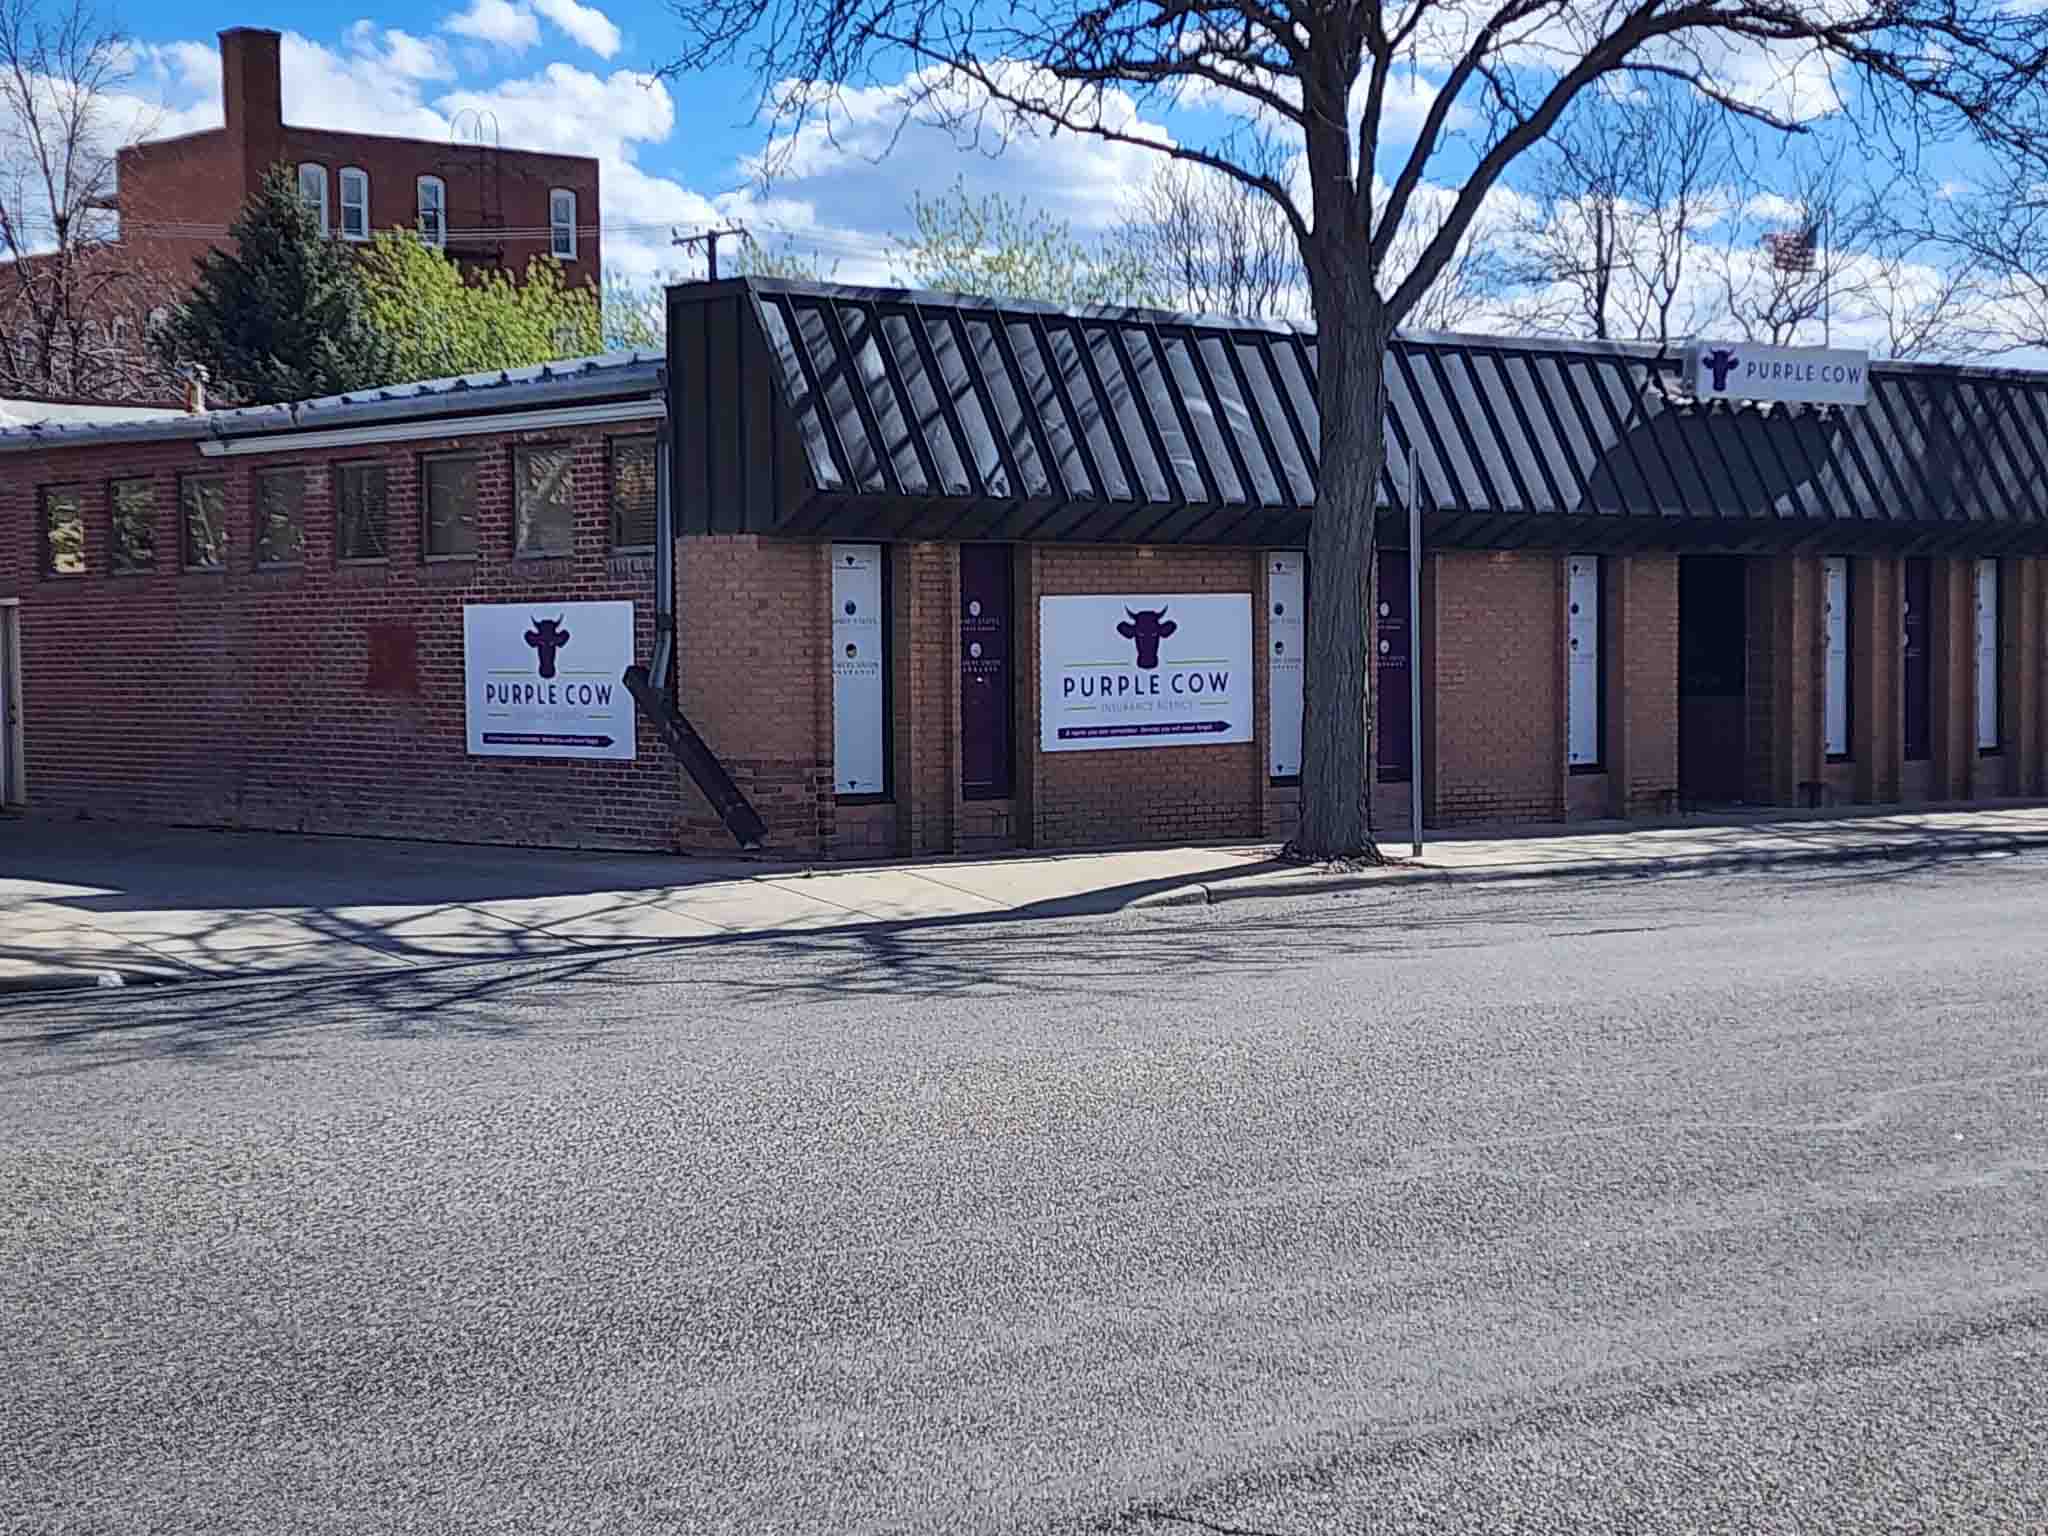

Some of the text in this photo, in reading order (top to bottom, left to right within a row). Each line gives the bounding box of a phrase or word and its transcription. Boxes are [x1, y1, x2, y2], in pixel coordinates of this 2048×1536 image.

[1747, 362, 1862, 384] PURPLE COW
[486, 683, 613, 705] PURPLE COW
[1063, 671, 1229, 698] PURPLE COW
